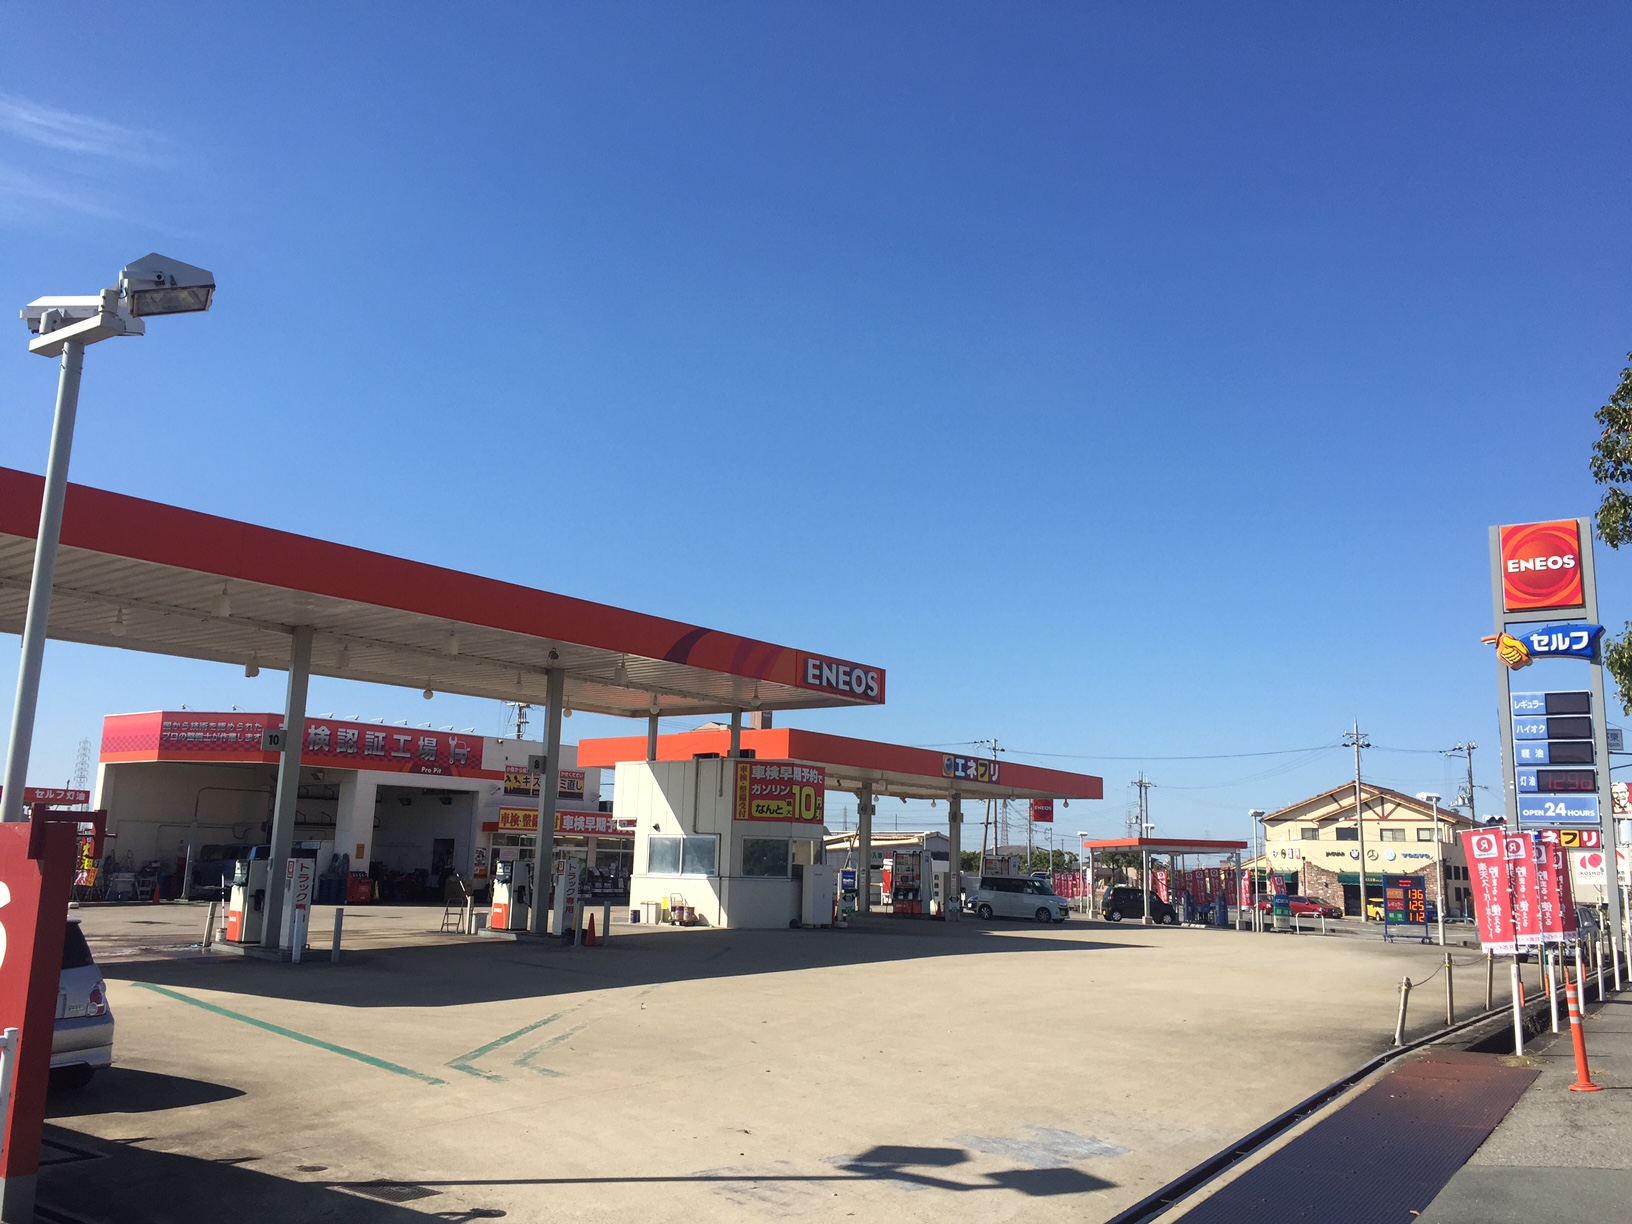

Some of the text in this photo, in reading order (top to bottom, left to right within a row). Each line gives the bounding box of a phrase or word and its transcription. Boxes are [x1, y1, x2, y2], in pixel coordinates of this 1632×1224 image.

[1507, 554, 1576, 573] ENEOS
[1530, 631, 1589, 651] セルフ
[806, 658, 878, 697] ENEOS
[1514, 699, 1544, 709] レギュラー
[163, 721, 262, 731] 国から技術を認められた
[1516, 724, 1545, 733] ハイオク
[268, 734, 280, 746] 10
[279, 724, 437, 761] 検認証工場
[1521, 749, 1544, 758] 軽油
[533, 760, 540, 769] 8
[954, 758, 999, 781] エネフリ
[752, 765, 823, 784] 車検早期予約で
[1520, 776, 1536, 786] 灯油
[35, 789, 85, 801] セルフ灯油
[752, 784, 790, 795] ガソリン
[792, 785, 815, 820] 10
[755, 804, 783, 815] なんと
[1544, 802, 1566, 816] 24
[1567, 809, 1595, 817] HOURS
[1533, 830, 1597, 846] ネフリ
[565, 863, 576, 913] トラック専用
[1408, 889, 1424, 900] 136
[1409, 901, 1425, 911] 125
[1409, 912, 1425, 922] 112
